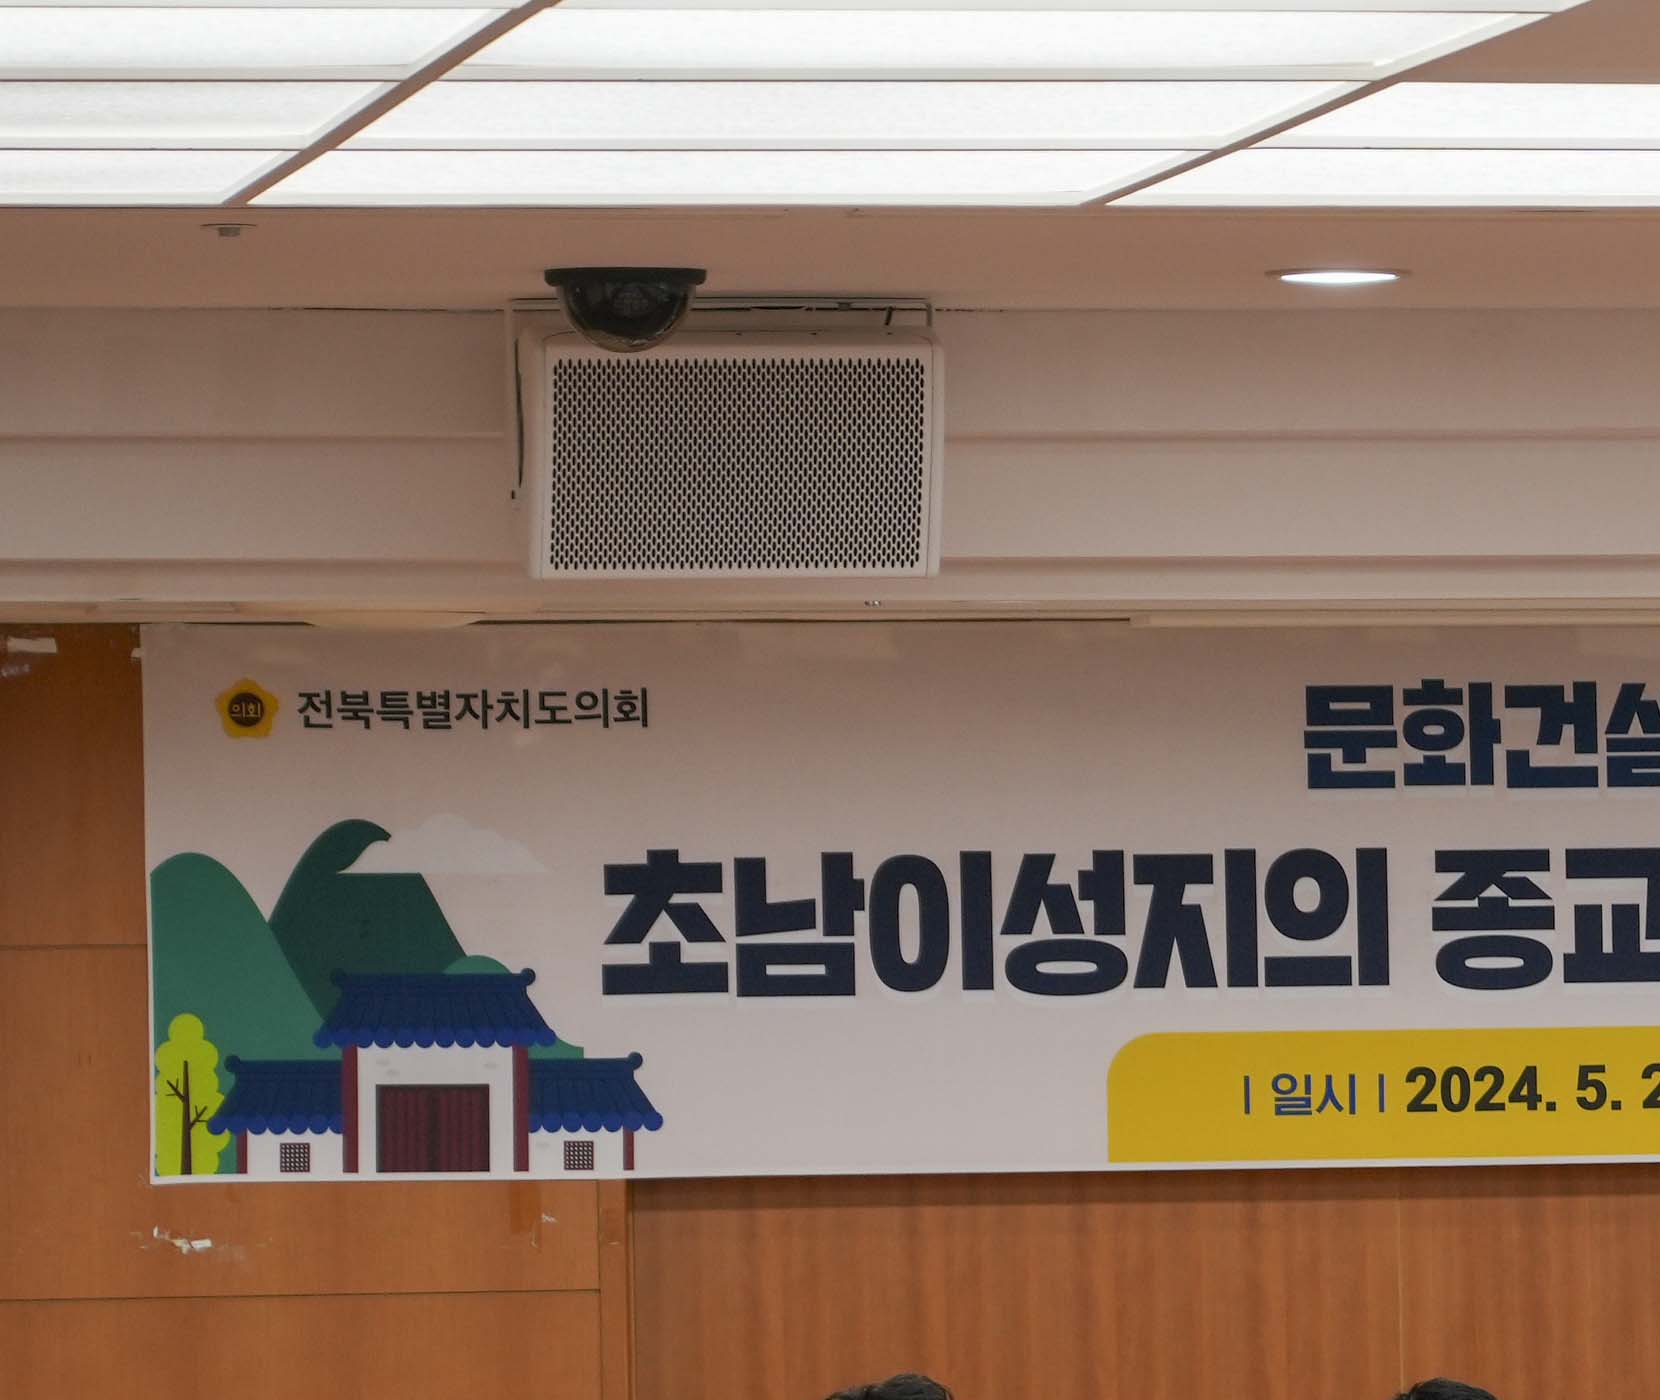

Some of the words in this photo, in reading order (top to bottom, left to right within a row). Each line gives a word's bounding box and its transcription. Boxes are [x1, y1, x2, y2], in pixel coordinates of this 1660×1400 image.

[297, 687, 649, 730] 전북특별자치도의회
[602, 847, 1391, 997] 초남이성지의
[1271, 1071, 1357, 1116] 일시
[1405, 1065, 1557, 1113] 2024.
[1575, 1064, 1623, 1111] 5.
